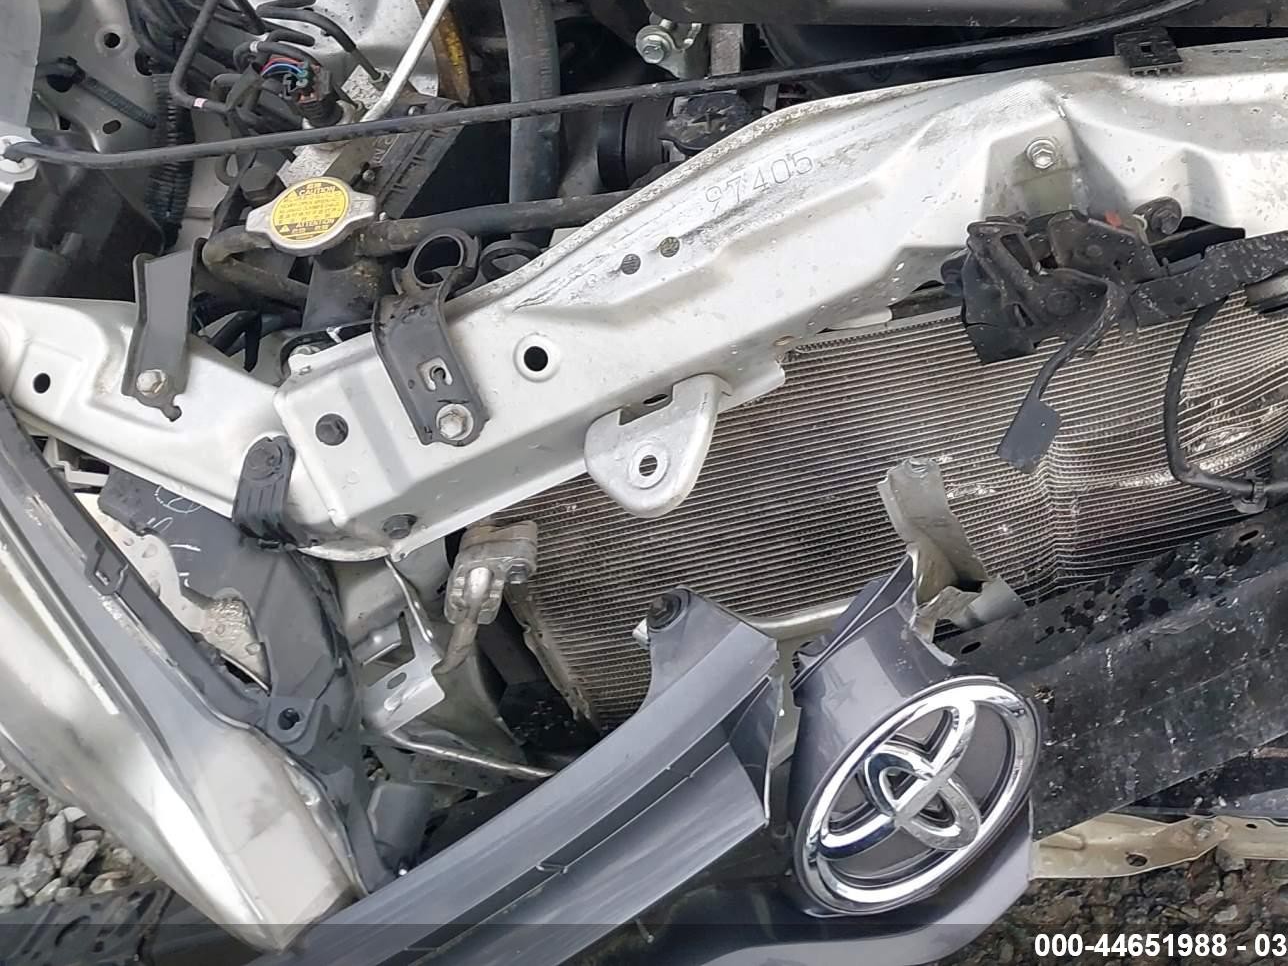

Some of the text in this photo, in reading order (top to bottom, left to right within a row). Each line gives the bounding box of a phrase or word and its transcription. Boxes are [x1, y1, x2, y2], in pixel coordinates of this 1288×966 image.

[704, 147, 814, 213] 97405
[299, 186, 335, 196] CAUTION
[295, 218, 335, 229] ATTENTION
